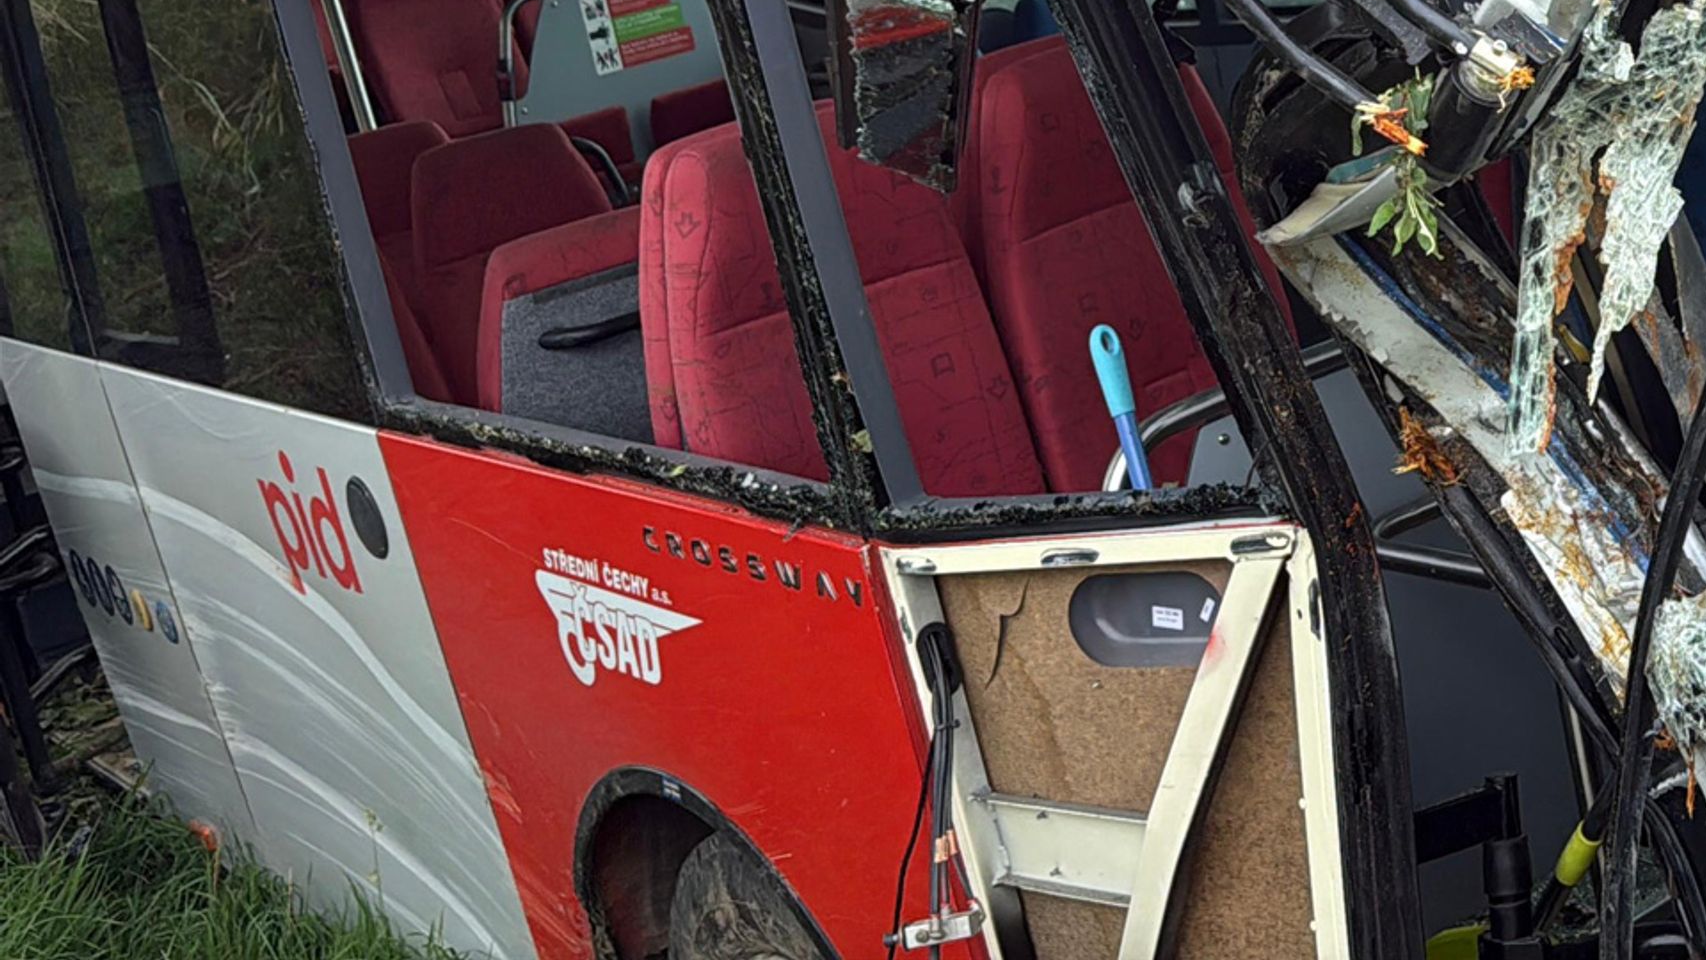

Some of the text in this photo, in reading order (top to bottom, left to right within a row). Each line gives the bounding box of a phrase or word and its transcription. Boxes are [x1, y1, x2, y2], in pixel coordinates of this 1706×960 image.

[256, 449, 365, 597] pid
[642, 525, 863, 607] CROSSWAY
[542, 547, 673, 606] STŘEDNÍ ČECHY a.s.
[558, 581, 662, 687] ČSAD
